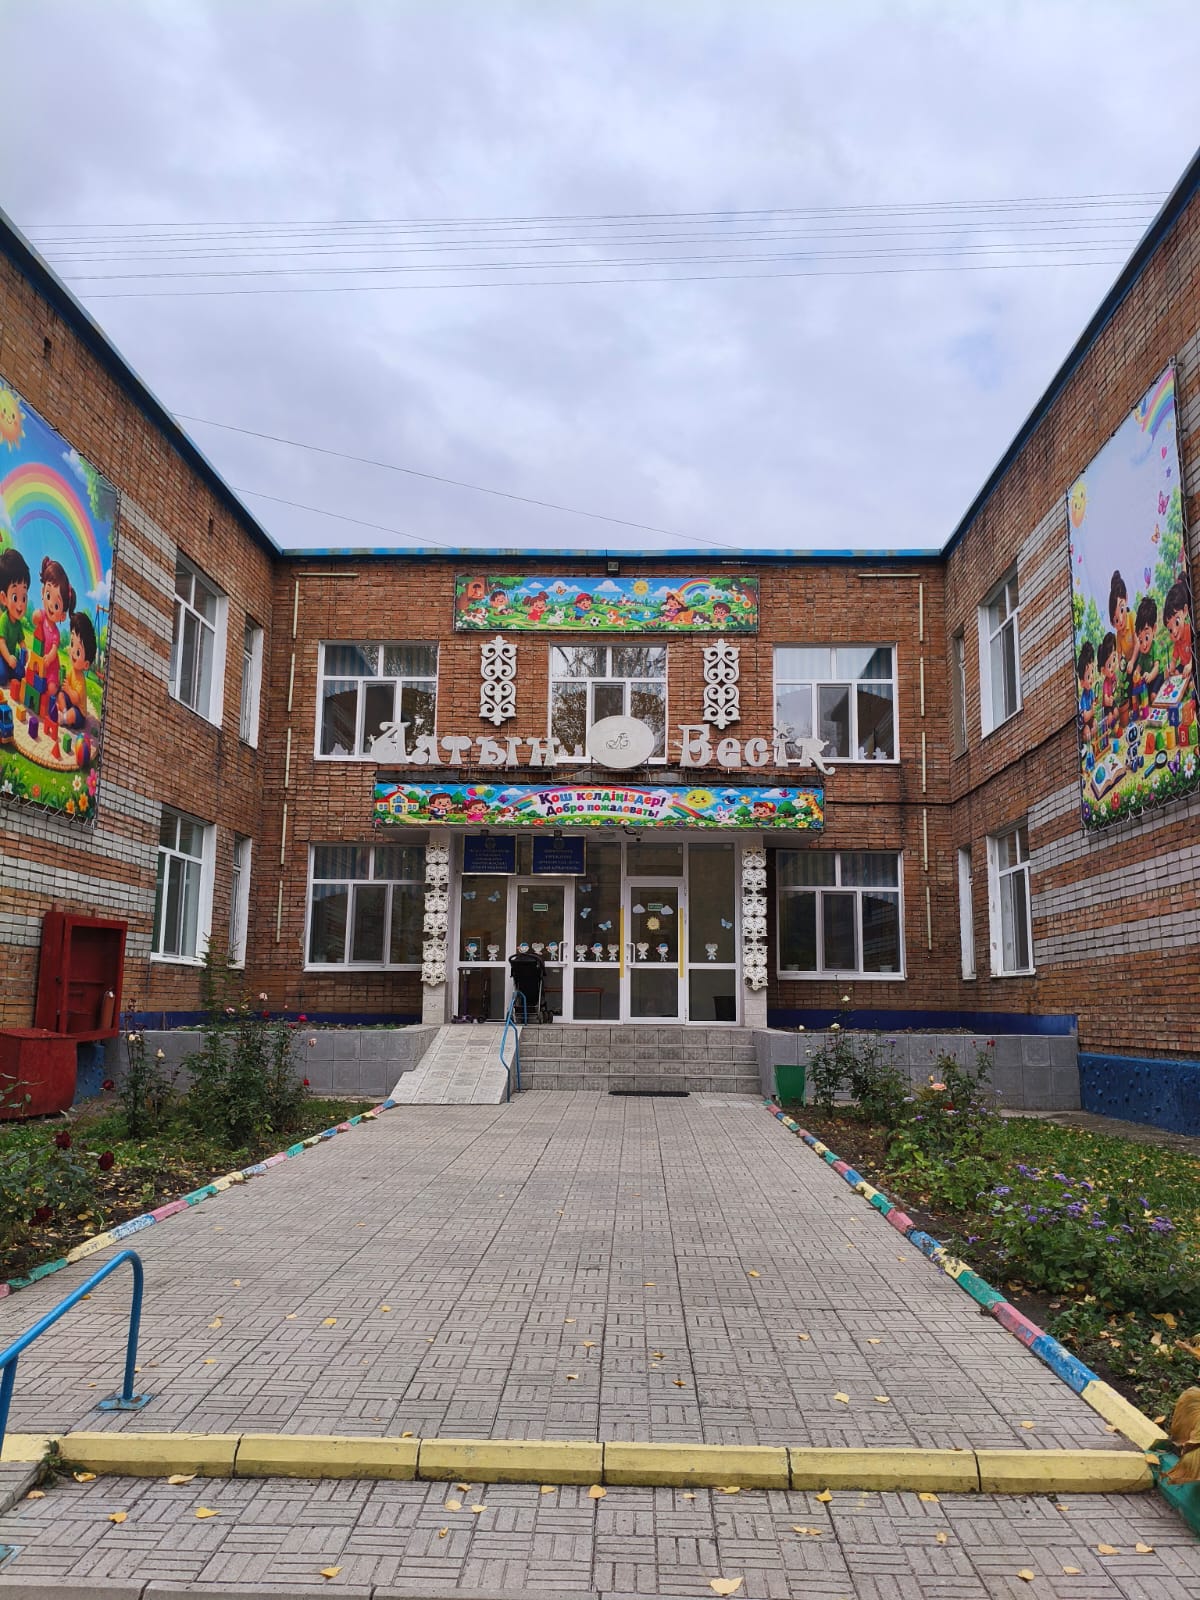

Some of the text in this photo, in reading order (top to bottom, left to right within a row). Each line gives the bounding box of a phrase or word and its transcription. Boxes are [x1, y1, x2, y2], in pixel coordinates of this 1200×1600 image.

[369, 720, 836, 776] Алтын Бесік
[538, 791, 573, 805] Қош
[546, 803, 660, 818] Добро пожаловать!
